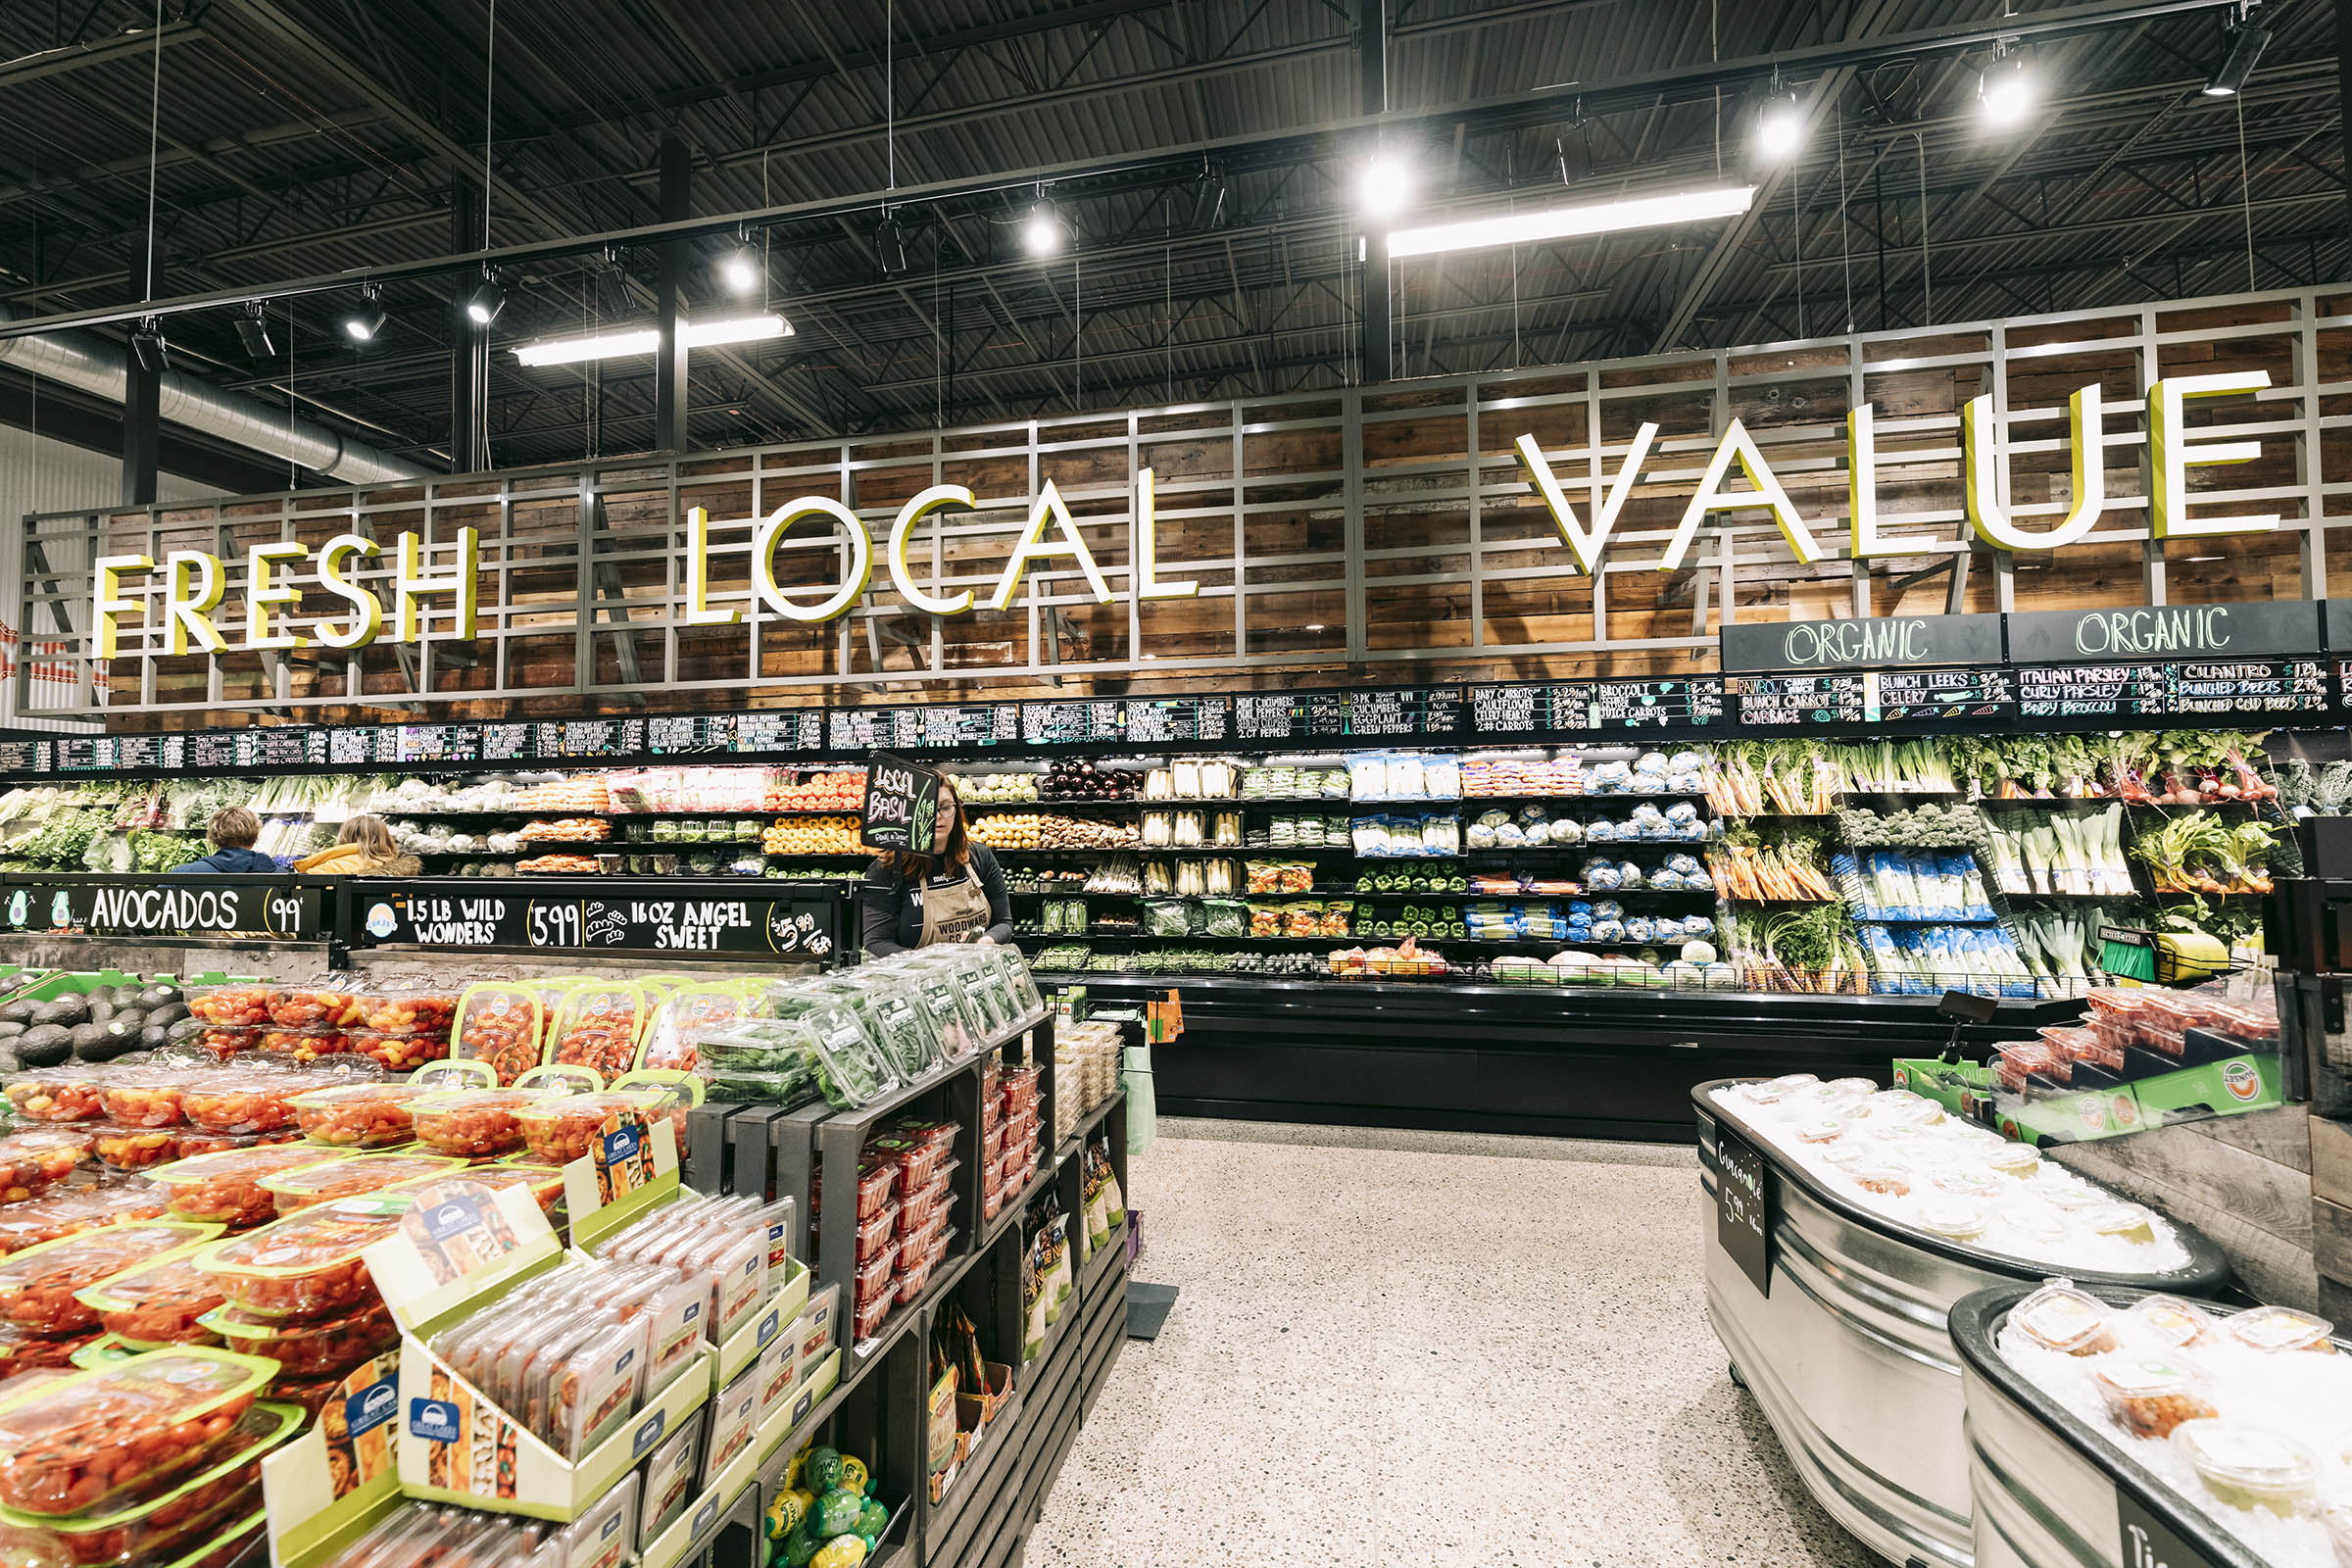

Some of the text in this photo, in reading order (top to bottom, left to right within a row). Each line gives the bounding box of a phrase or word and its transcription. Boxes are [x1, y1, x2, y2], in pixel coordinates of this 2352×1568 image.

[92, 371, 2280, 660] FRESH LOCAL VALUE
[2076, 607, 2231, 655] ORGANIC
[1785, 620, 1929, 664] ORGANIC
[2020, 667, 2131, 685] ITALIAN PARSLEY
[2184, 664, 2272, 680] CILANTRO
[1739, 679, 1783, 695] RAINBOW
[1881, 674, 1969, 690] BUNCH LEEKS
[2179, 681, 2236, 697] BUNCHED
[2237, 679, 2281, 695] BEETS
[1475, 689, 1494, 700] BABY
[1496, 688, 1534, 700] CARROTS
[1600, 684, 1650, 698] BROCCOLI
[1881, 690, 1928, 706] CELERY
[2020, 684, 2123, 701] CURLY PARSLEY
[1236, 697, 1295, 709] MINI CUCUMBERS
[1352, 702, 1449, 714] CUCUMBERS N/A
[1474, 699, 1535, 710] CAULIFLOWER
[1742, 694, 1831, 710] BUNCH CARROT
[2020, 700, 2117, 716] BABY BROCCOLI
[2180, 696, 2298, 713] BUNCHED GOLD BEETS
[1236, 708, 1287, 719] MINI PEPPERS
[1352, 713, 1402, 725] EGGPLANT
[1475, 710, 1531, 721] CELERY HEARTS
[1600, 706, 1667, 718] JUICE CARROTS
[1740, 710, 1801, 725] CABBAGE
[1260, 727, 1291, 737] PEPPERS
[1353, 723, 1413, 736] GREEN PEPPERS
[1495, 720, 1534, 731] CARROTS
[874, 764, 917, 801] LOCAL
[867, 791, 913, 824] BASIL
[90, 888, 240, 929] AVOCADOS
[408, 899, 428, 922] 1.5
[432, 899, 453, 921] LB
[461, 899, 506, 921] WILD
[683, 902, 752, 927] ANGEL
[938, 912, 988, 935] WOODWARD
[414, 922, 497, 944] WONDERS
[654, 925, 721, 951] SWEET
[2224, 1069, 2255, 1084] SUNSET
